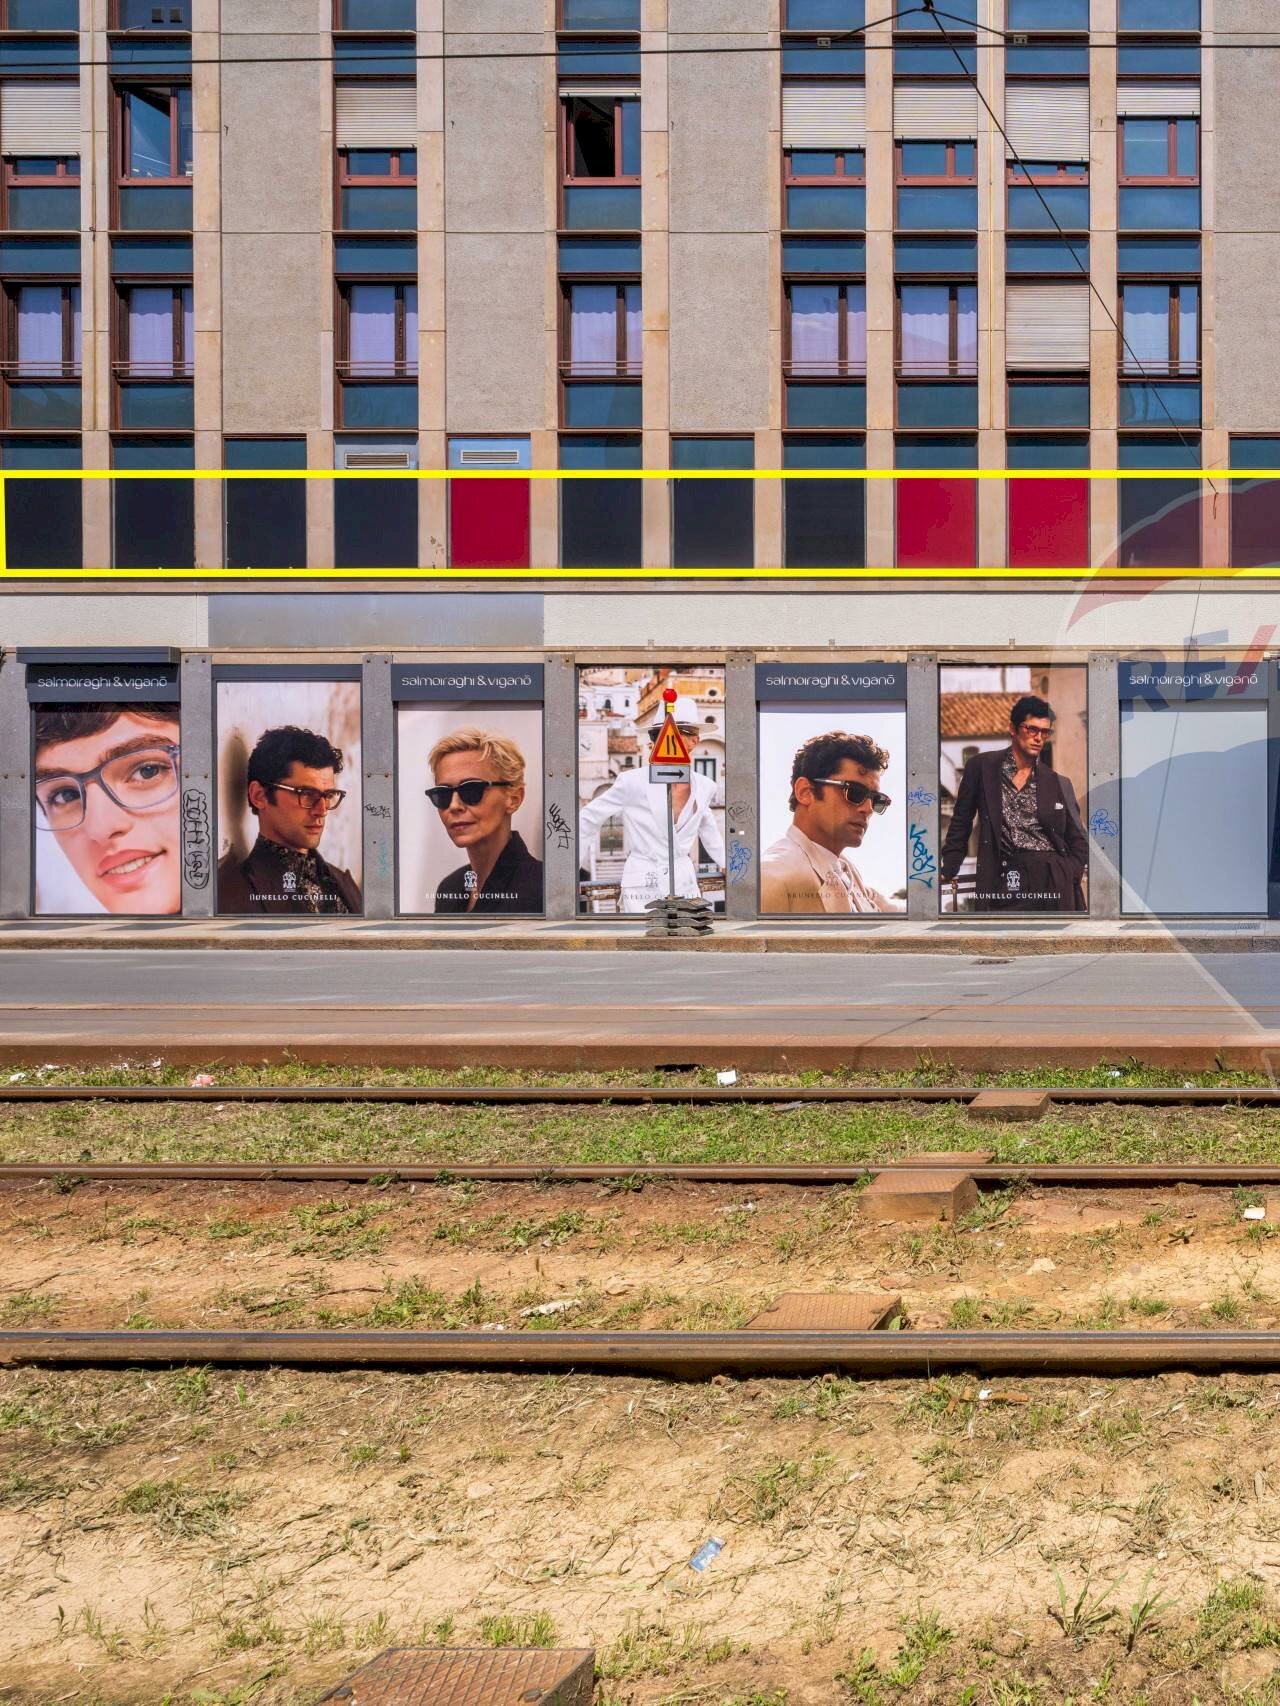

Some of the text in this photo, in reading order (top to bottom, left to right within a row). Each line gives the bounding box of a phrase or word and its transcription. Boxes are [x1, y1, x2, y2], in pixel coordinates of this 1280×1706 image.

[37, 676, 111, 690] salmoiraghi
[401, 675, 475, 689] salmoiraghi
[765, 675, 839, 688] salmoiraghi
[1129, 674, 1202, 687] salmoiraghi
[291, 893, 337, 901] CUCINELLI
[472, 892, 518, 900] CUCINELLI
[968, 892, 1061, 900] BRUNELLO CUCINELLI
